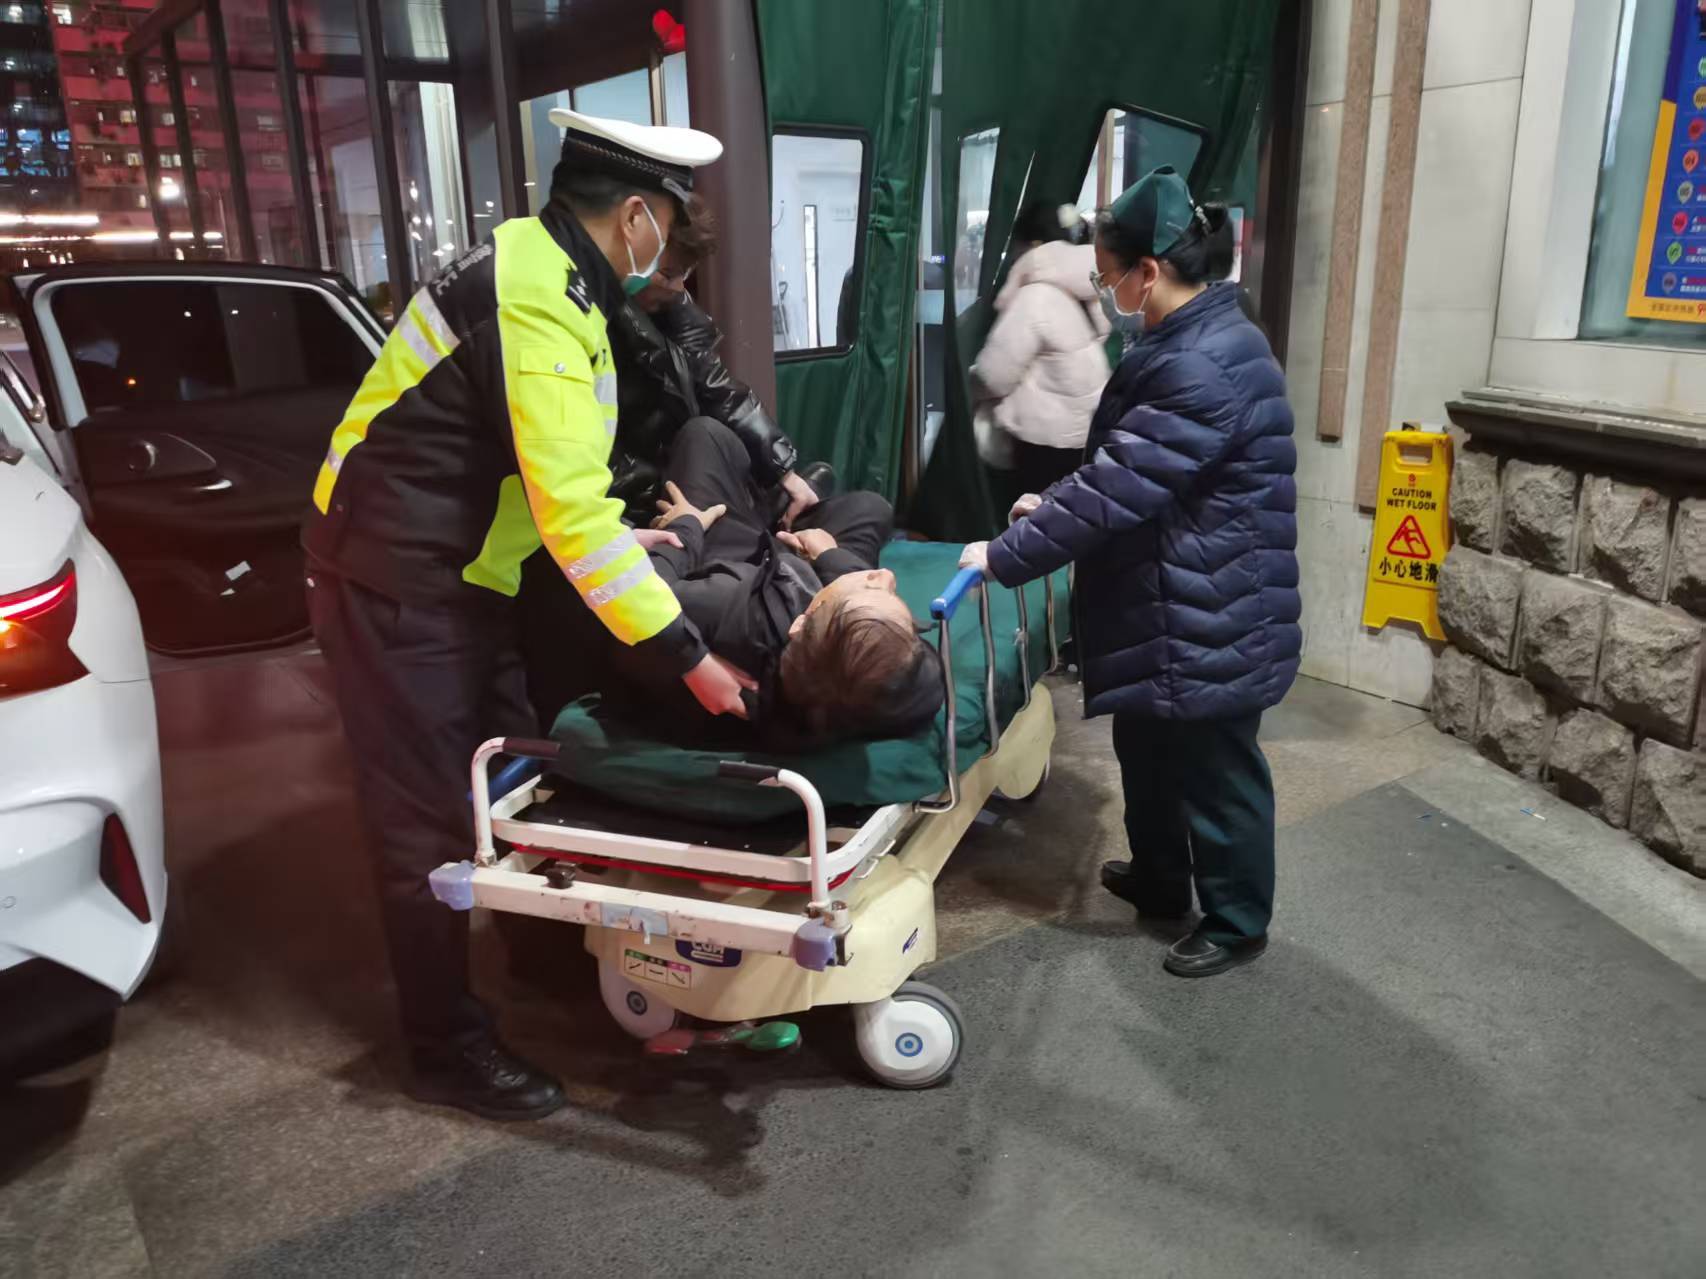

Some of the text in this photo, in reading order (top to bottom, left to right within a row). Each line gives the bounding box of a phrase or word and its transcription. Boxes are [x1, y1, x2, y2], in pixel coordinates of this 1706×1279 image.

[1392, 488, 1432, 499] CAUTION
[1387, 499, 1437, 511] WET FLOOR
[1379, 557, 1440, 583] 小心地滑
